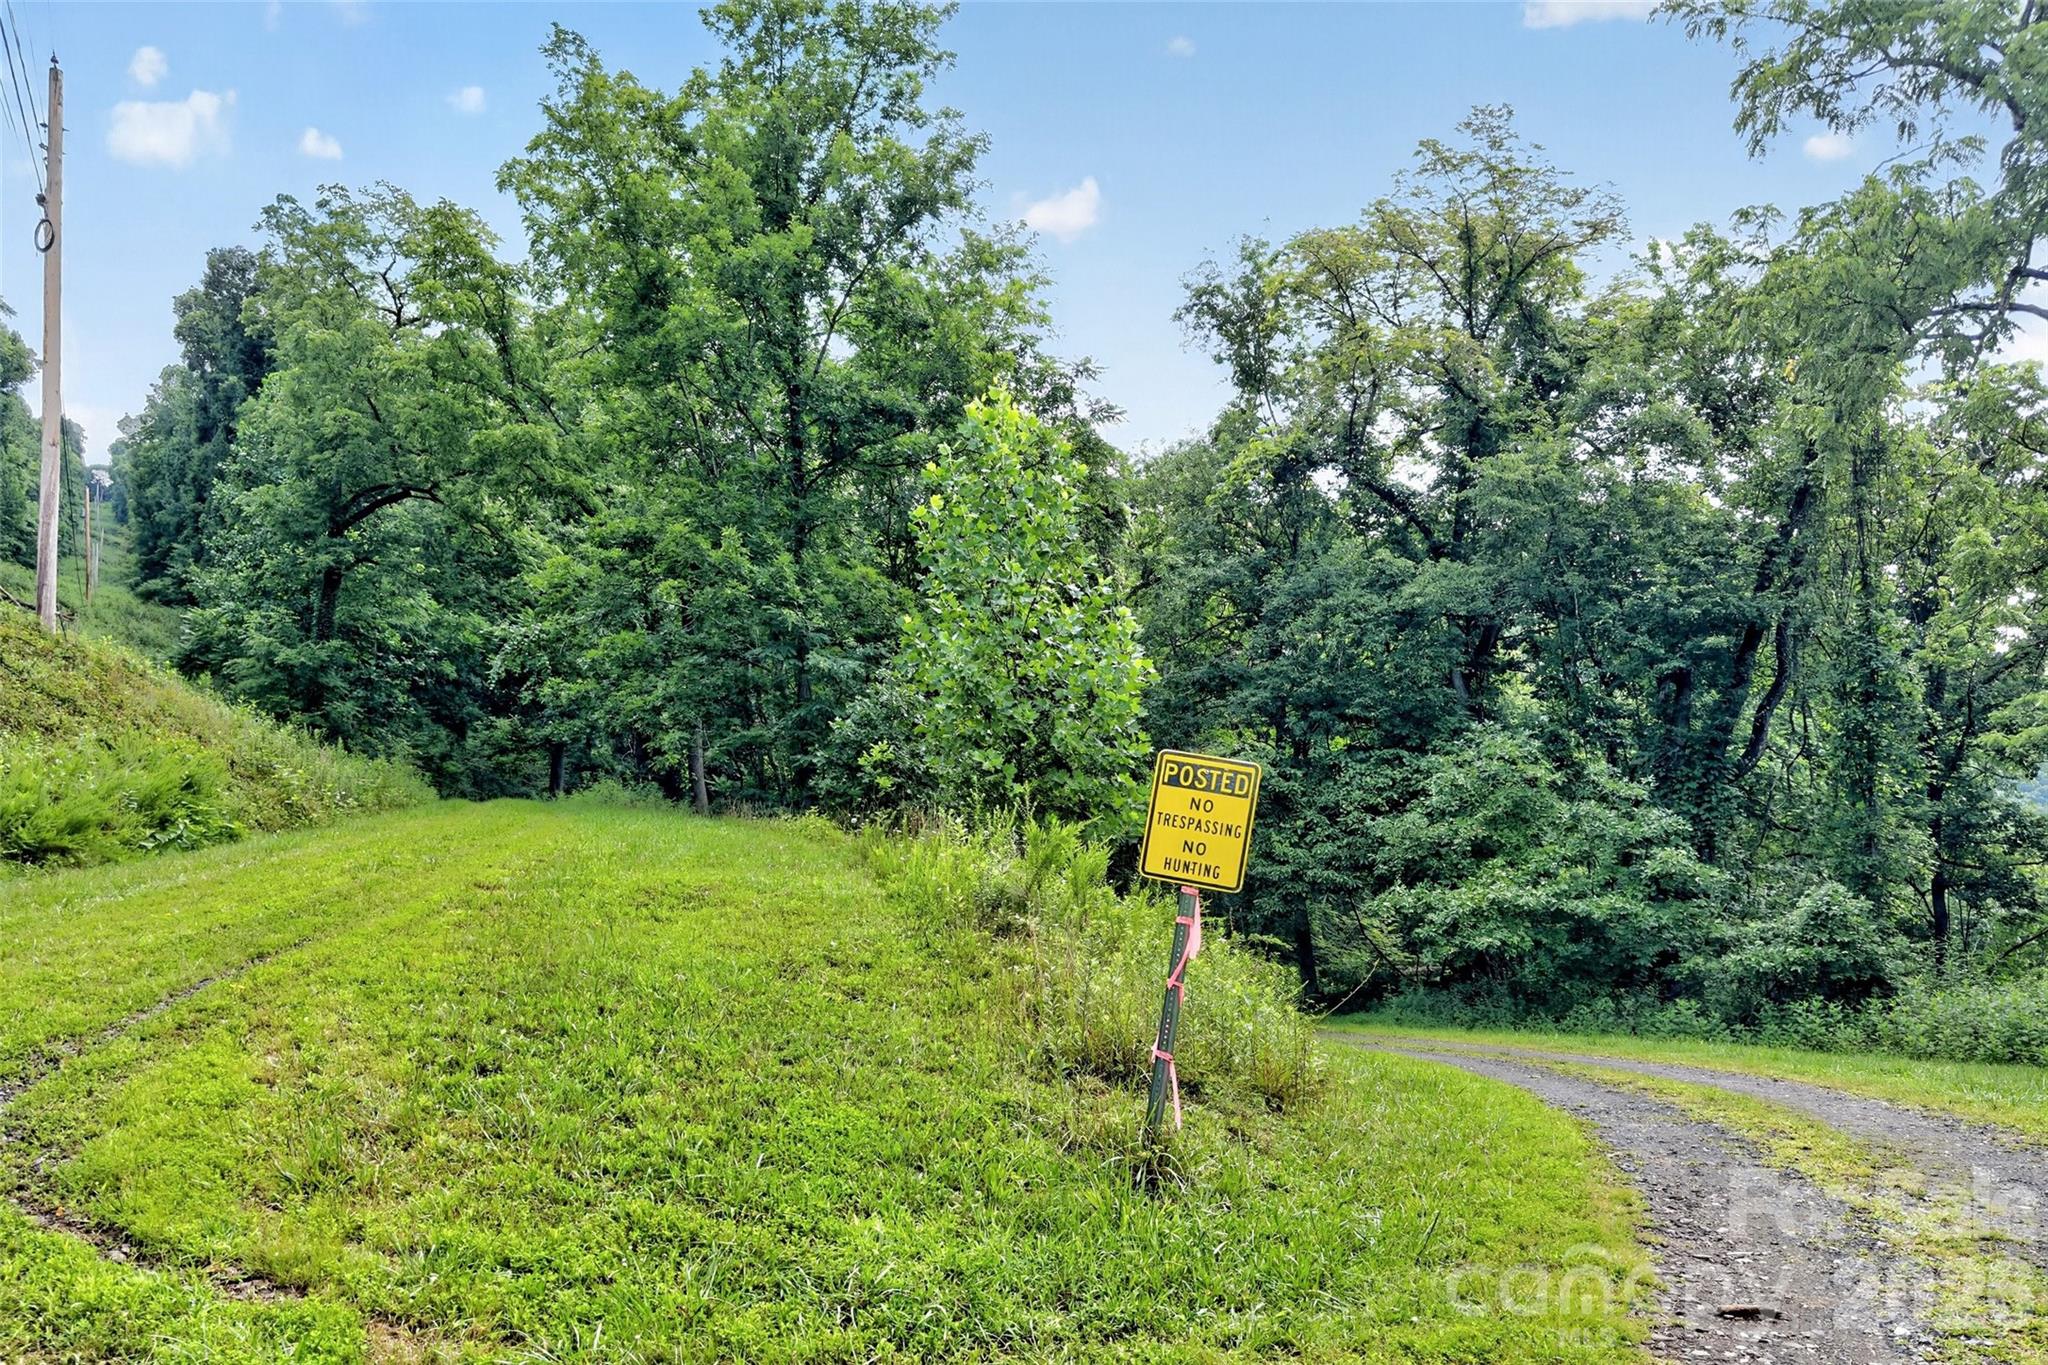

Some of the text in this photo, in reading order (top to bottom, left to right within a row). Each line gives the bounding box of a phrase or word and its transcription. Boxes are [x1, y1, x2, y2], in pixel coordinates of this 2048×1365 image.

[1164, 763, 1249, 795] POSTED
[1190, 797, 1214, 813] NO
[1157, 812, 1242, 839] TRESPASSING
[1182, 840, 1206, 856] NO
[1164, 857, 1221, 880] HUNTING
